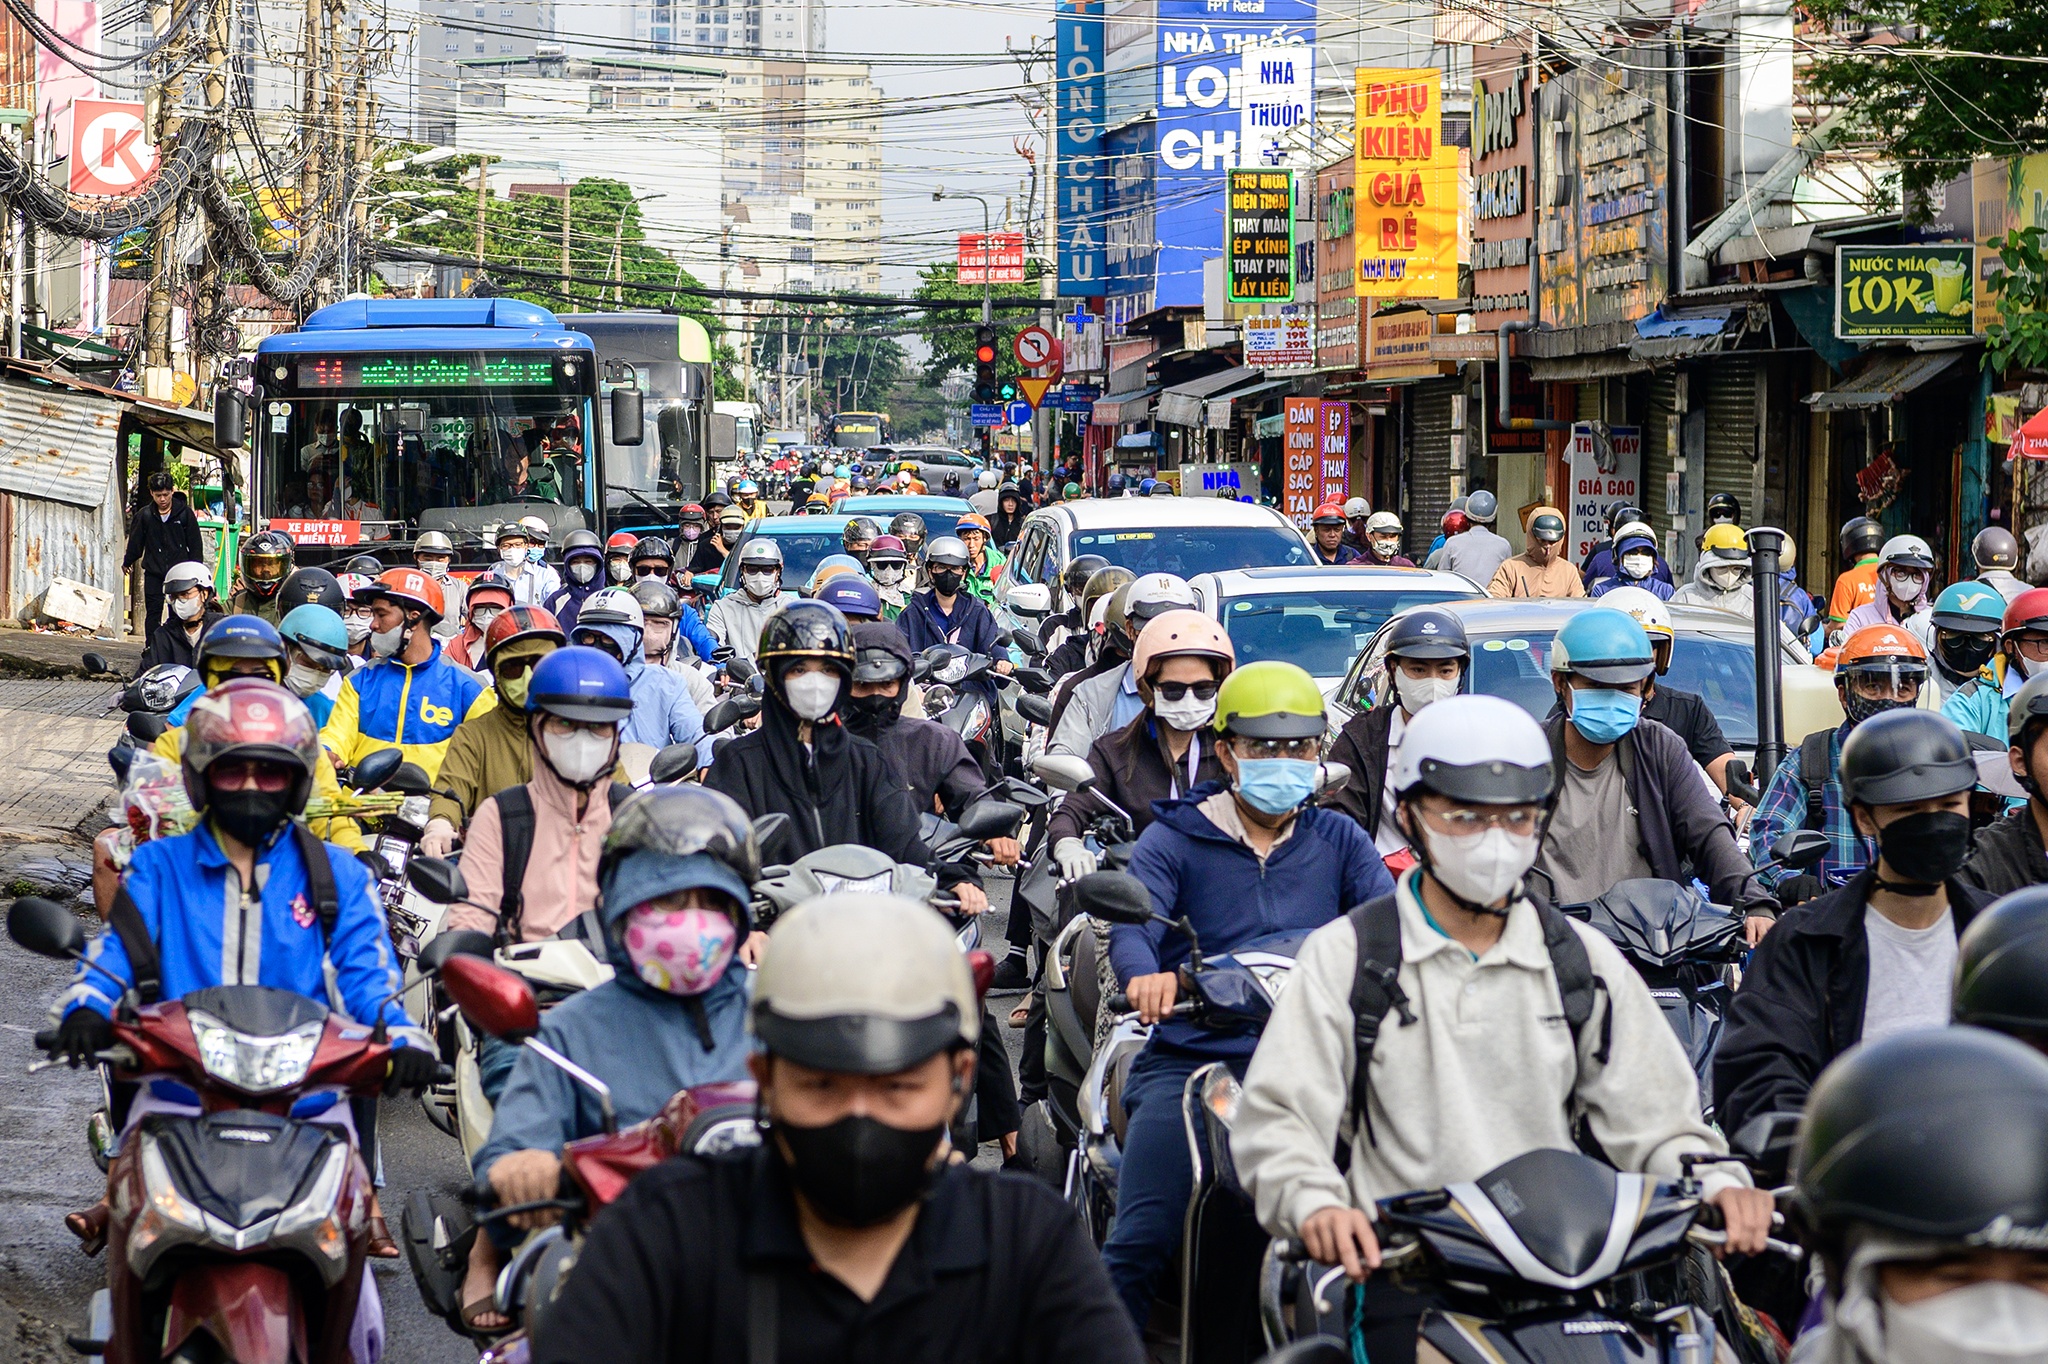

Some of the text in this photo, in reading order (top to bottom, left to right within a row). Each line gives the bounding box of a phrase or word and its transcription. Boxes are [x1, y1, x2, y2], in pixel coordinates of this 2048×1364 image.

[1207, 1, 1265, 13] FPT Retail
[1163, 24, 1215, 53] NHÀ
[1260, 58, 1294, 84] NHÀ
[1068, 26, 1094, 143] LONG
[1162, 65, 1242, 109] LO
[1250, 97, 1304, 128] THUỐC
[1369, 83, 1428, 121] PHỤ
[102, 128, 137, 168] K
[1160, 128, 1237, 170] CH
[1364, 122, 1432, 164] KIỆN
[1260, 174, 1288, 189] MUA
[1372, 168, 1425, 205] GIÁ
[1233, 191, 1257, 212] ĐIỆN
[1069, 156, 1095, 282] CHÂU
[1233, 216, 1288, 233] THAY MÀN
[1380, 211, 1417, 249] RẺ
[1233, 236, 1288, 254] ÉP KÍNH
[1234, 259, 1289, 274] THAY PIN
[1363, 257, 1386, 282] NHẬT
[1389, 259, 1407, 278] HUY
[1849, 256, 1926, 272] NƯỚC MÍA
[1233, 279, 1289, 296] LẤY LIỀN
[1843, 275, 1925, 314] 10K
[1285, 340, 1309, 349] 29K
[1286, 331, 1307, 339] 19K
[1290, 406, 1314, 424] DÁN
[1329, 409, 1341, 431] ÉP
[1289, 427, 1314, 449] KÍNH
[1324, 433, 1346, 454] KÍNH
[1575, 437, 1592, 453] TH
[2029, 438, 2048, 448] THA
[1289, 450, 1313, 471] CÁP
[1324, 460, 1346, 478] THAY
[1203, 469, 1240, 490] NHÀ
[1289, 474, 1313, 492] SẠC
[1578, 477, 1635, 496] GIÁ CAO
[1576, 500, 1597, 517] MỞ
[288, 519, 343, 533] XE BUÝT ĐI
[327, 532, 347, 545] TÂY
[1873, 645, 1908, 653] Ahamove
[420, 696, 453, 726] be
